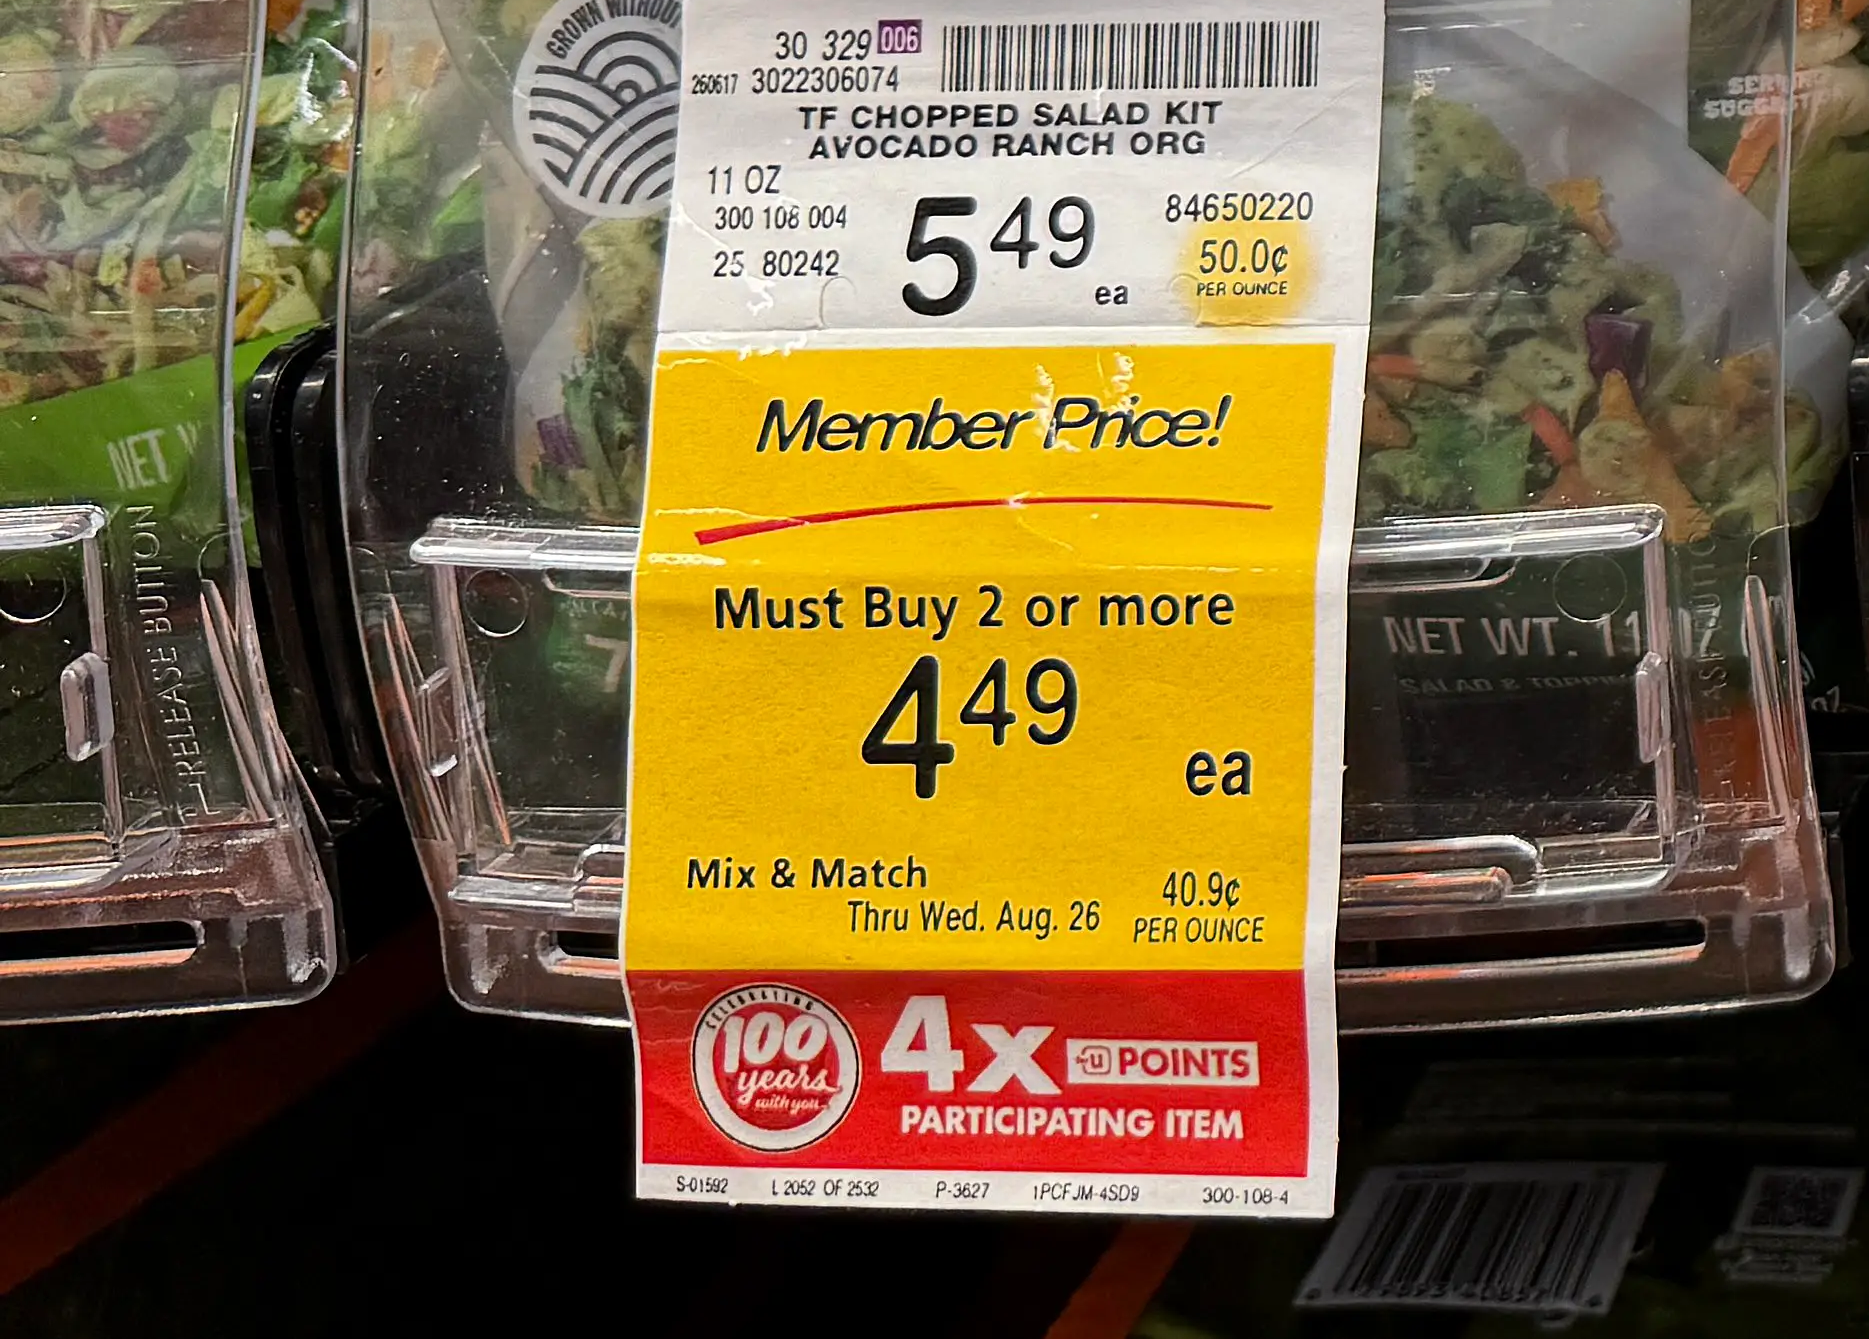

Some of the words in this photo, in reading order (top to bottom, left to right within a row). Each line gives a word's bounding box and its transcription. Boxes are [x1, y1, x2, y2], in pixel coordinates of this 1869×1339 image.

[775, 31, 808, 60] 30
[822, 29, 872, 60] 329
[880, 24, 920, 54] 006
[691, 72, 738, 95] 260617
[751, 66, 900, 94] 3022306074
[799, 105, 837, 131] TF
[851, 104, 1018, 130] CHOPPED
[1033, 101, 1150, 127] SALAD
[1165, 99, 1224, 125] KIT
[808, 134, 977, 160] AVOCADO
[992, 131, 1115, 158] RANCH
[1129, 130, 1206, 157] ORG
[708, 167, 733, 196] 11
[745, 166, 781, 194] OZ
[714, 206, 754, 230] 300
[763, 205, 800, 230] 108
[808, 204, 848, 229] 004
[1165, 192, 1313, 222] 84650220
[713, 252, 743, 277] 25
[763, 249, 840, 277] 80242
[1198, 239, 1288, 277] 50.0¢
[1196, 280, 1228, 298] PER
[1233, 280, 1288, 297] OUNCE
[1162, 871, 1241, 911] 40.9¢
[936, 1181, 990, 1201] P-3627
[1202, 1188, 1289, 1206] 300-108-4
